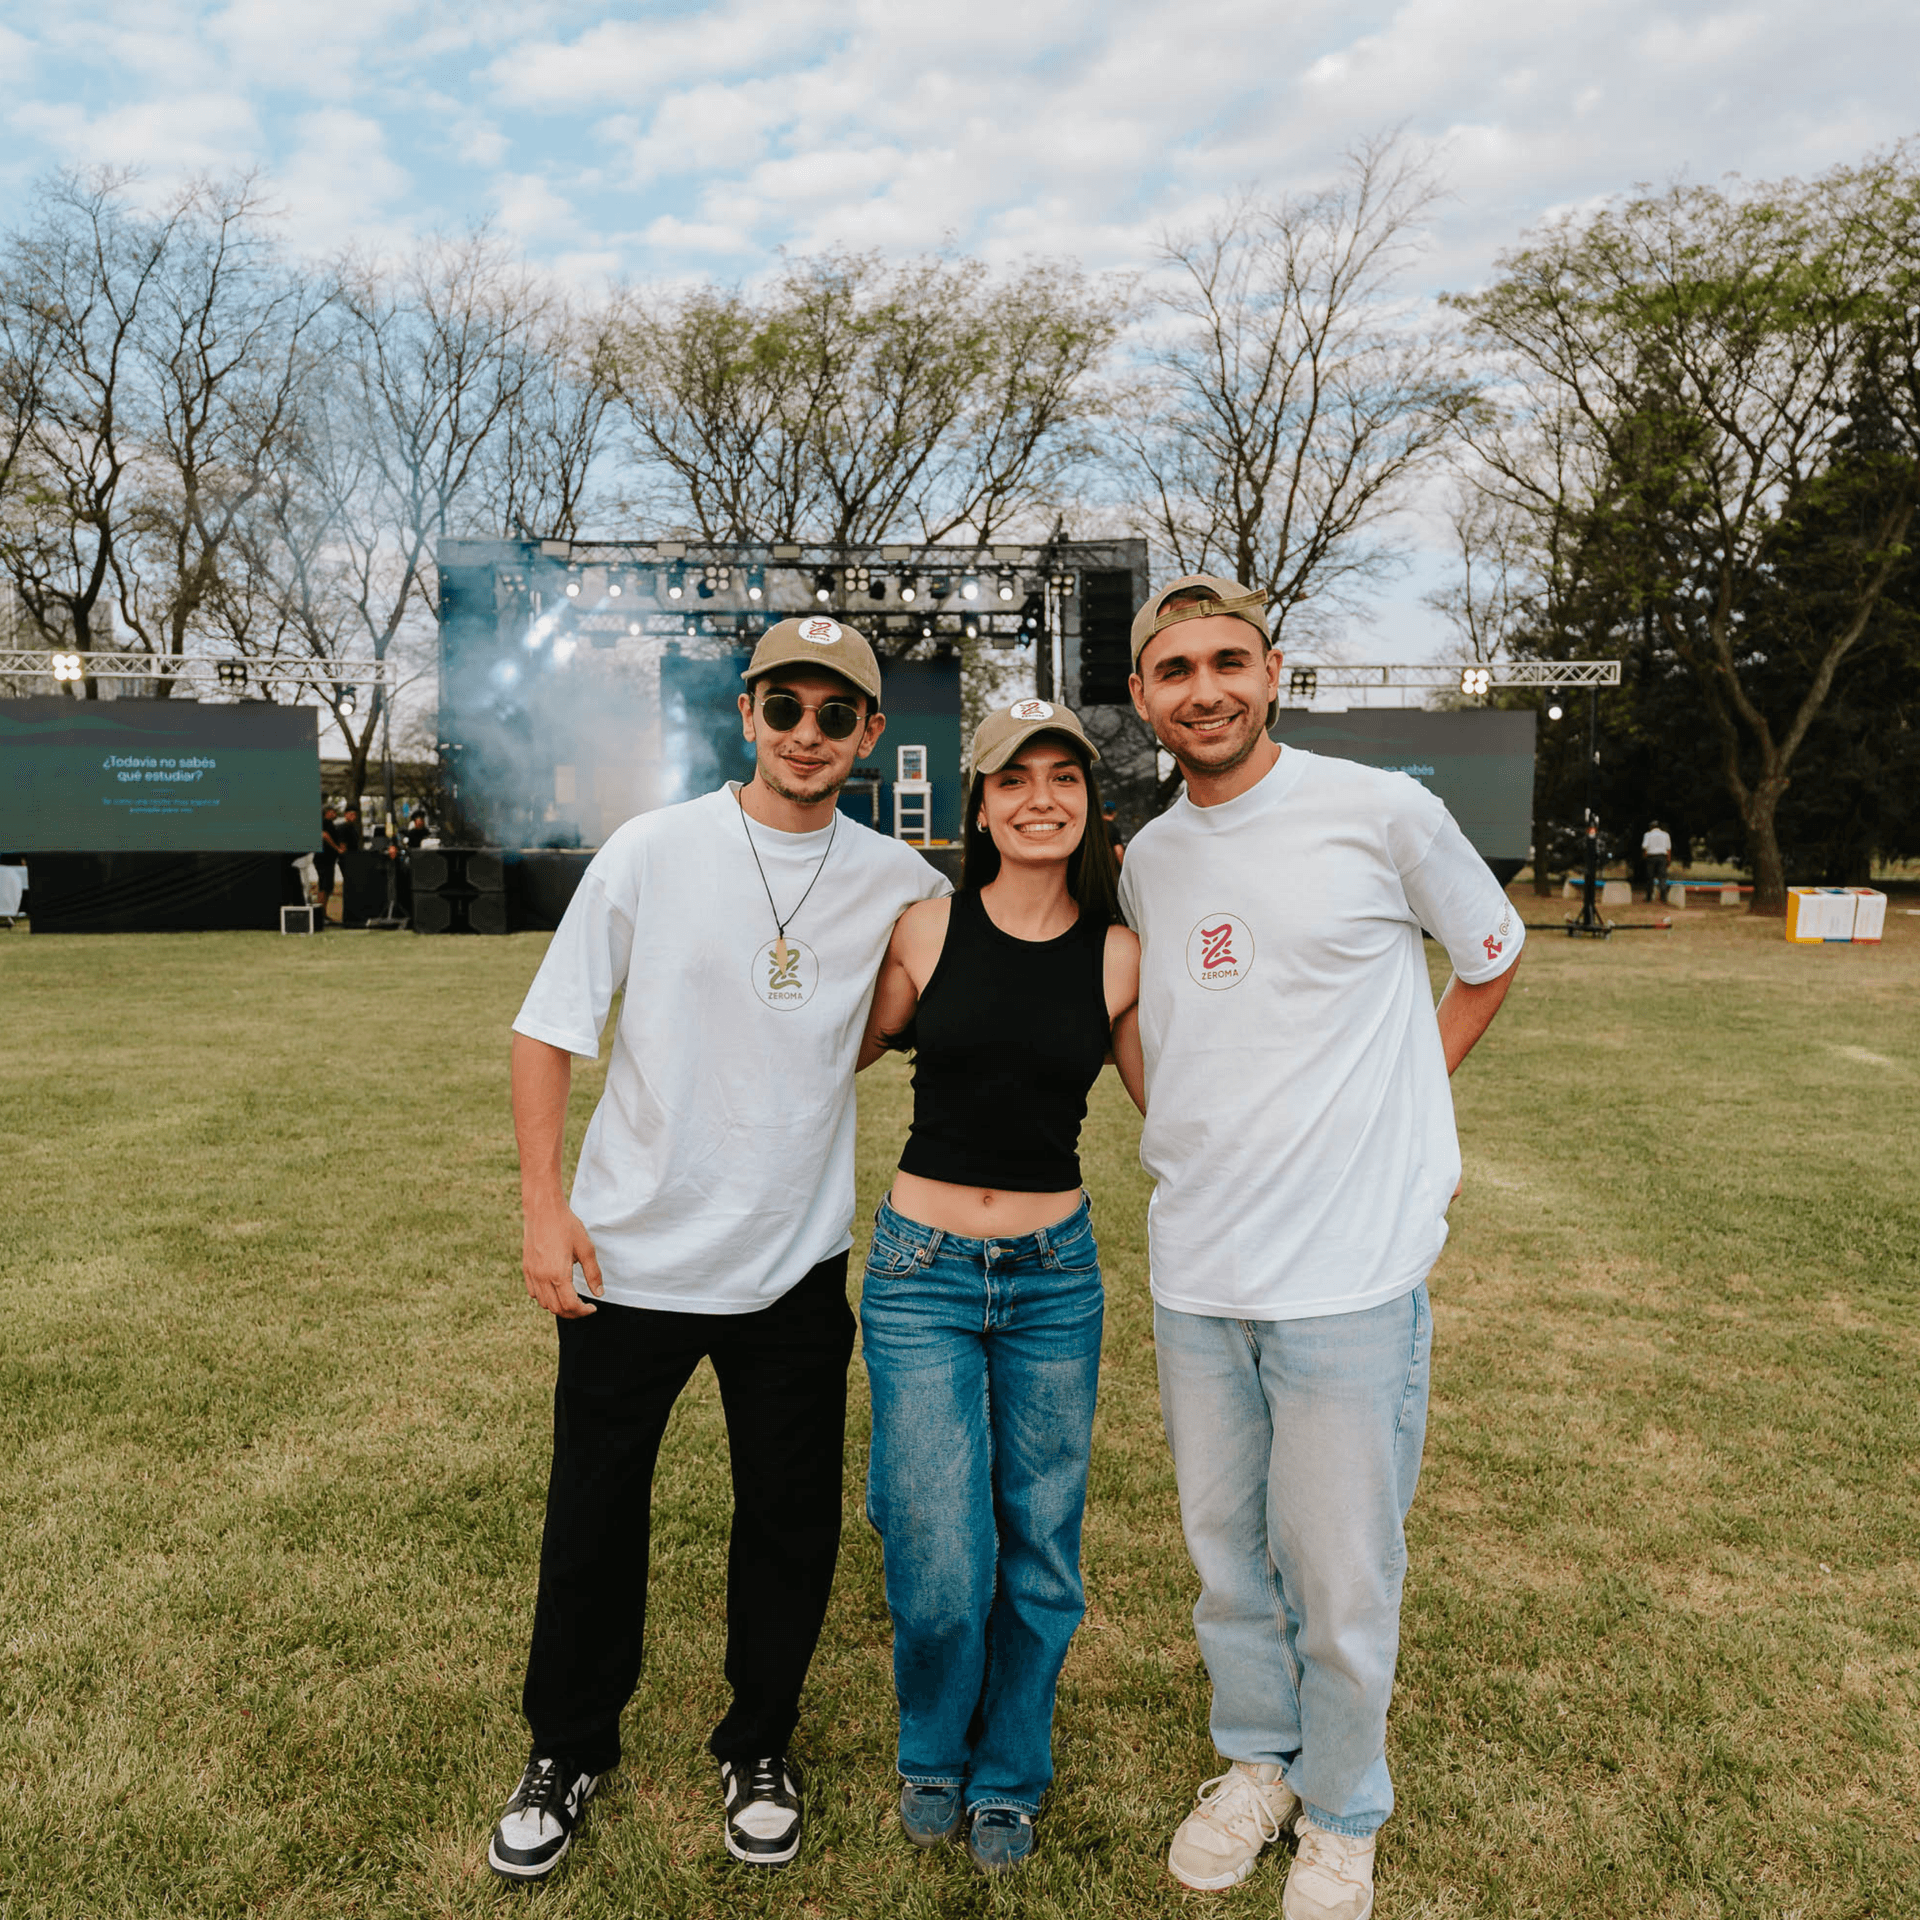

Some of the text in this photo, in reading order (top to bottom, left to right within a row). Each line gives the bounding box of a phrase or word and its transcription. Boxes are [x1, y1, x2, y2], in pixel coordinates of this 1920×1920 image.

[160, 758, 177, 768] no
[179, 757, 216, 768] sabés
[117, 770, 204, 783] qué estudiar?
[1201, 969, 1239, 980] ZEROMA
[768, 991, 803, 1000] ZEROMA
